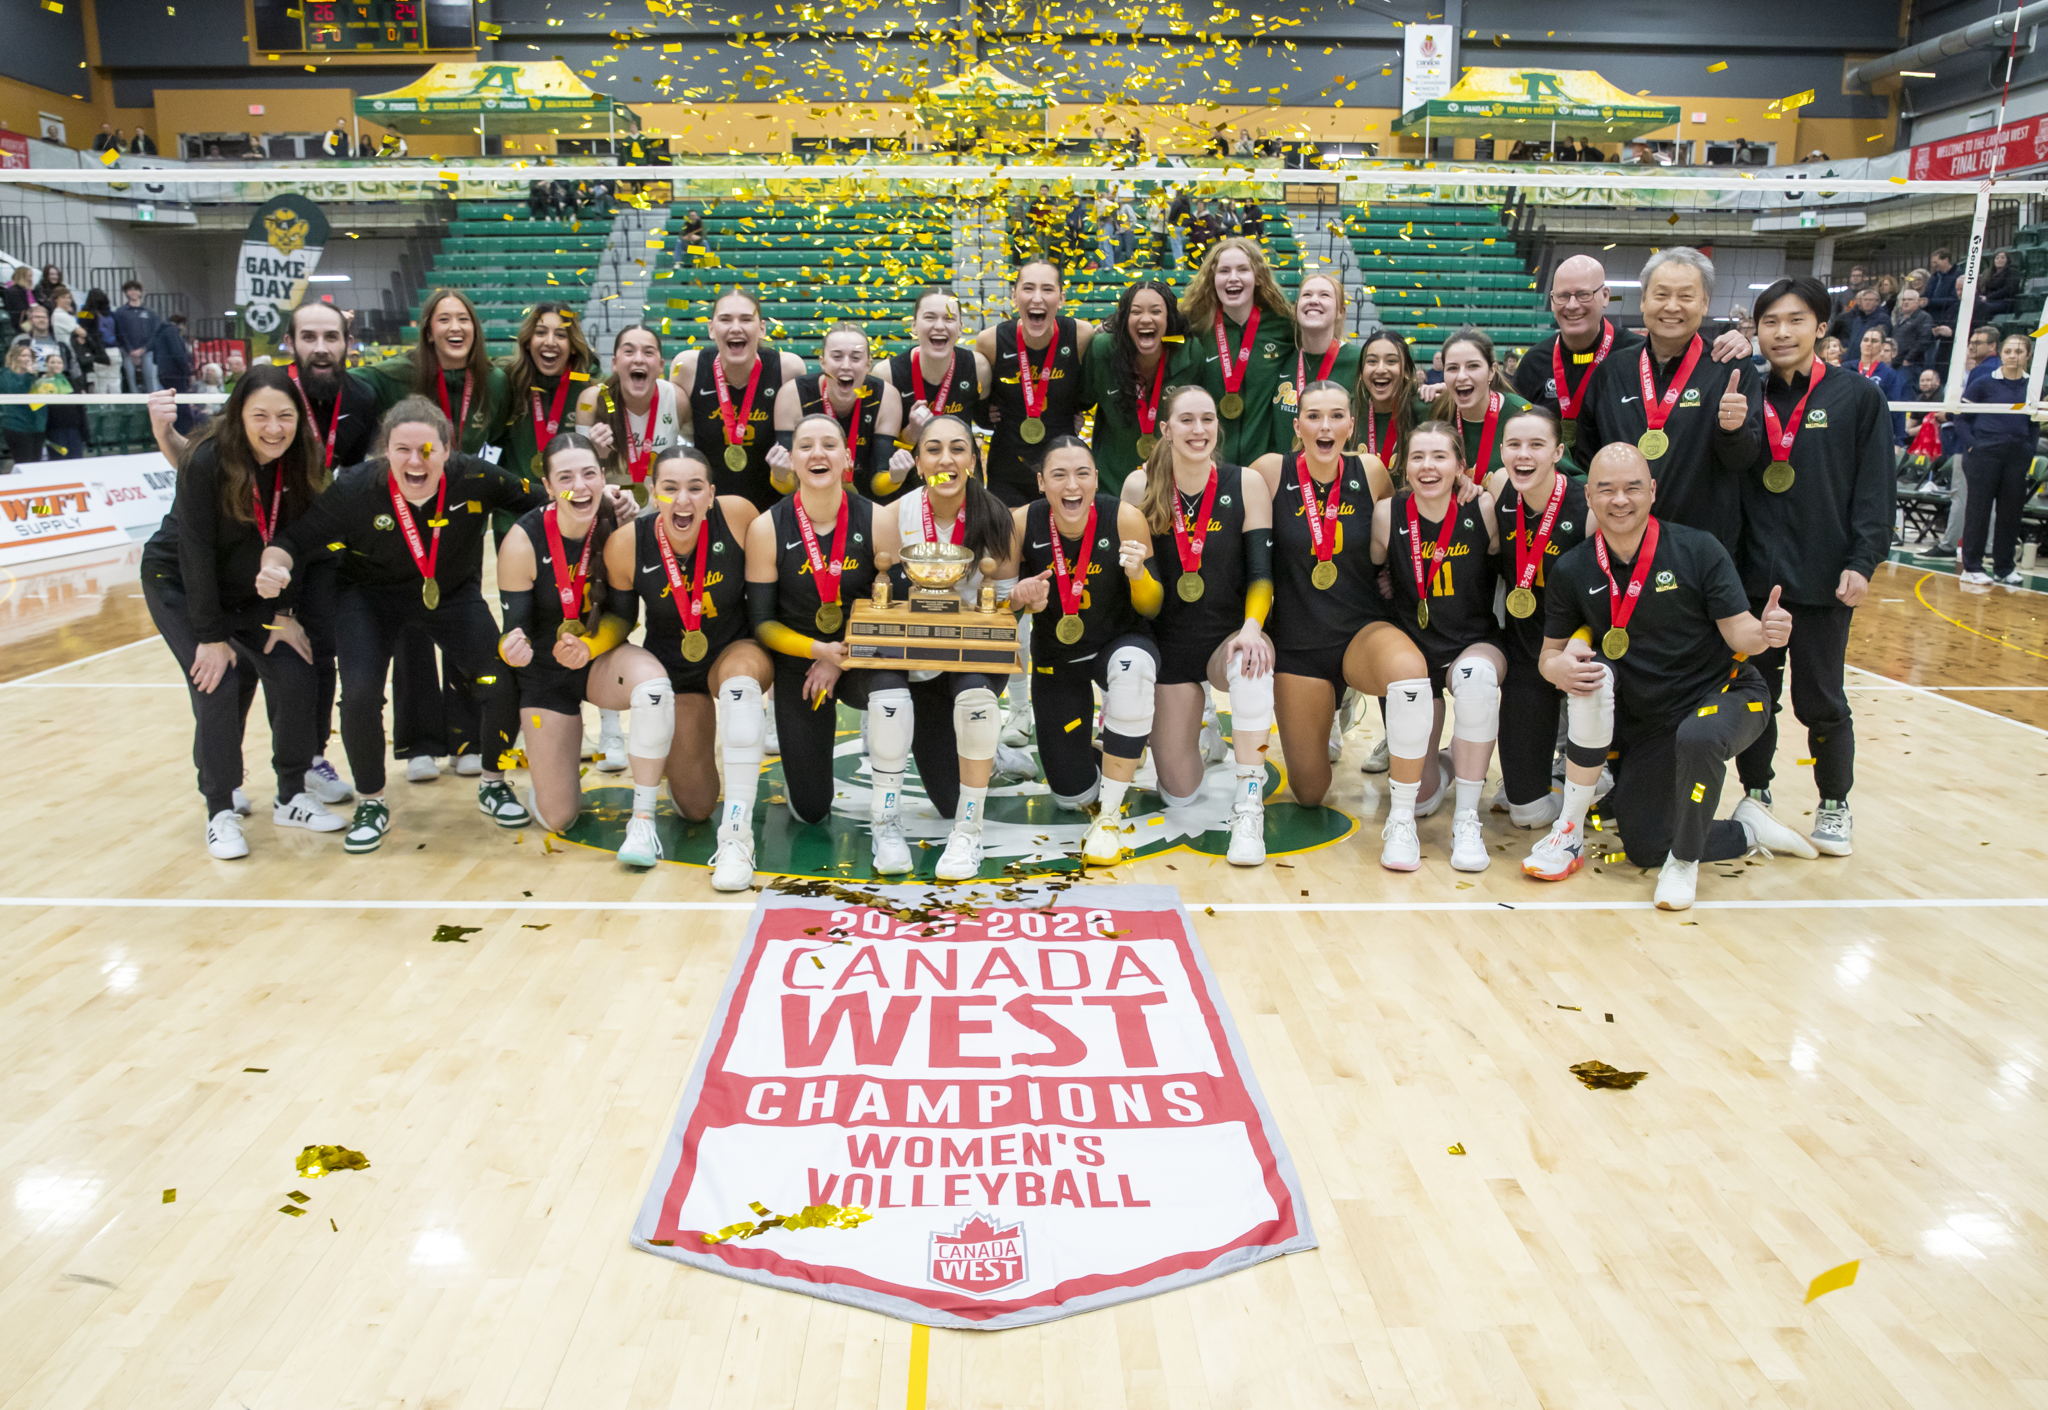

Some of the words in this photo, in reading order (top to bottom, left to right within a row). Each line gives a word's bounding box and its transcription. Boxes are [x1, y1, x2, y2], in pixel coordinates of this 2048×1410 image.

[313, 5, 335, 21] 26
[358, 7, 367, 18] 4
[395, 4, 416, 20] 24
[1573, 109, 1599, 117] PANDAS
[1616, 110, 1642, 118] GOLDEN
[1936, 141, 1964, 158] WELCOME
[2010, 125, 2030, 142] WEST
[1951, 153, 1977, 176] FINAL
[246, 257, 305, 279] GAME
[1967, 246, 1979, 285] Senoh
[251, 278, 294, 300] DAY
[0, 491, 91, 522] WIFT
[1303, 481, 1318, 517] VOLLEYBALL
[15, 517, 82, 537] SUPPLY
[796, 505, 814, 542] VOLLEYBALL
[1310, 516, 1324, 546] WOMEN'S
[1538, 501, 1559, 536] VOLLEYBALL
[406, 527, 425, 558] WOMEN'S
[1410, 519, 1421, 555] VOLLEYBALL
[807, 541, 823, 572] WOMEN'S
[1054, 547, 1067, 576] WOMEN'S
[1414, 554, 1423, 583] WOMEN'S
[667, 557, 683, 588] WOMEN'S
[1433, 561, 1455, 597] 11
[782, 944, 1164, 991] CANADA
[781, 991, 1168, 1069] WEST
[746, 1081, 1205, 1124] CHAMPIONS
[847, 1132, 1106, 1169] WOMEN'S
[807, 1167, 1151, 1209] VOLLEYBALL
[939, 1240, 1018, 1259] CANADA
[939, 1258, 1020, 1282] WEST
